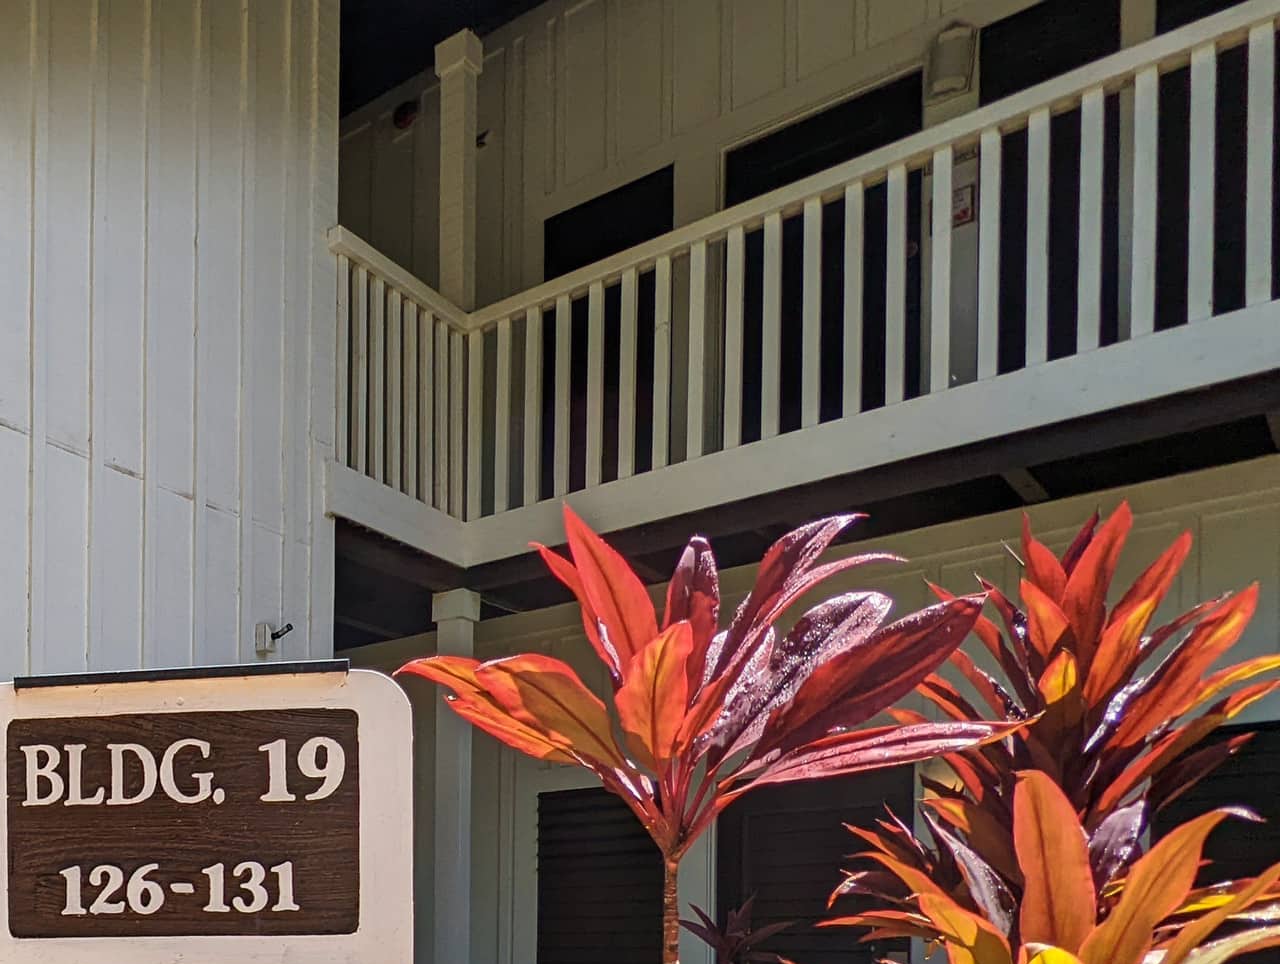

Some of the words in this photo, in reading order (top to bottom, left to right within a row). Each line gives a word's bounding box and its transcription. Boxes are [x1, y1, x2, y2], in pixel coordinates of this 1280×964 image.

[20, 738, 225, 807] BLDG.
[258, 736, 346, 802] 19
[59, 861, 301, 916] 126-131
